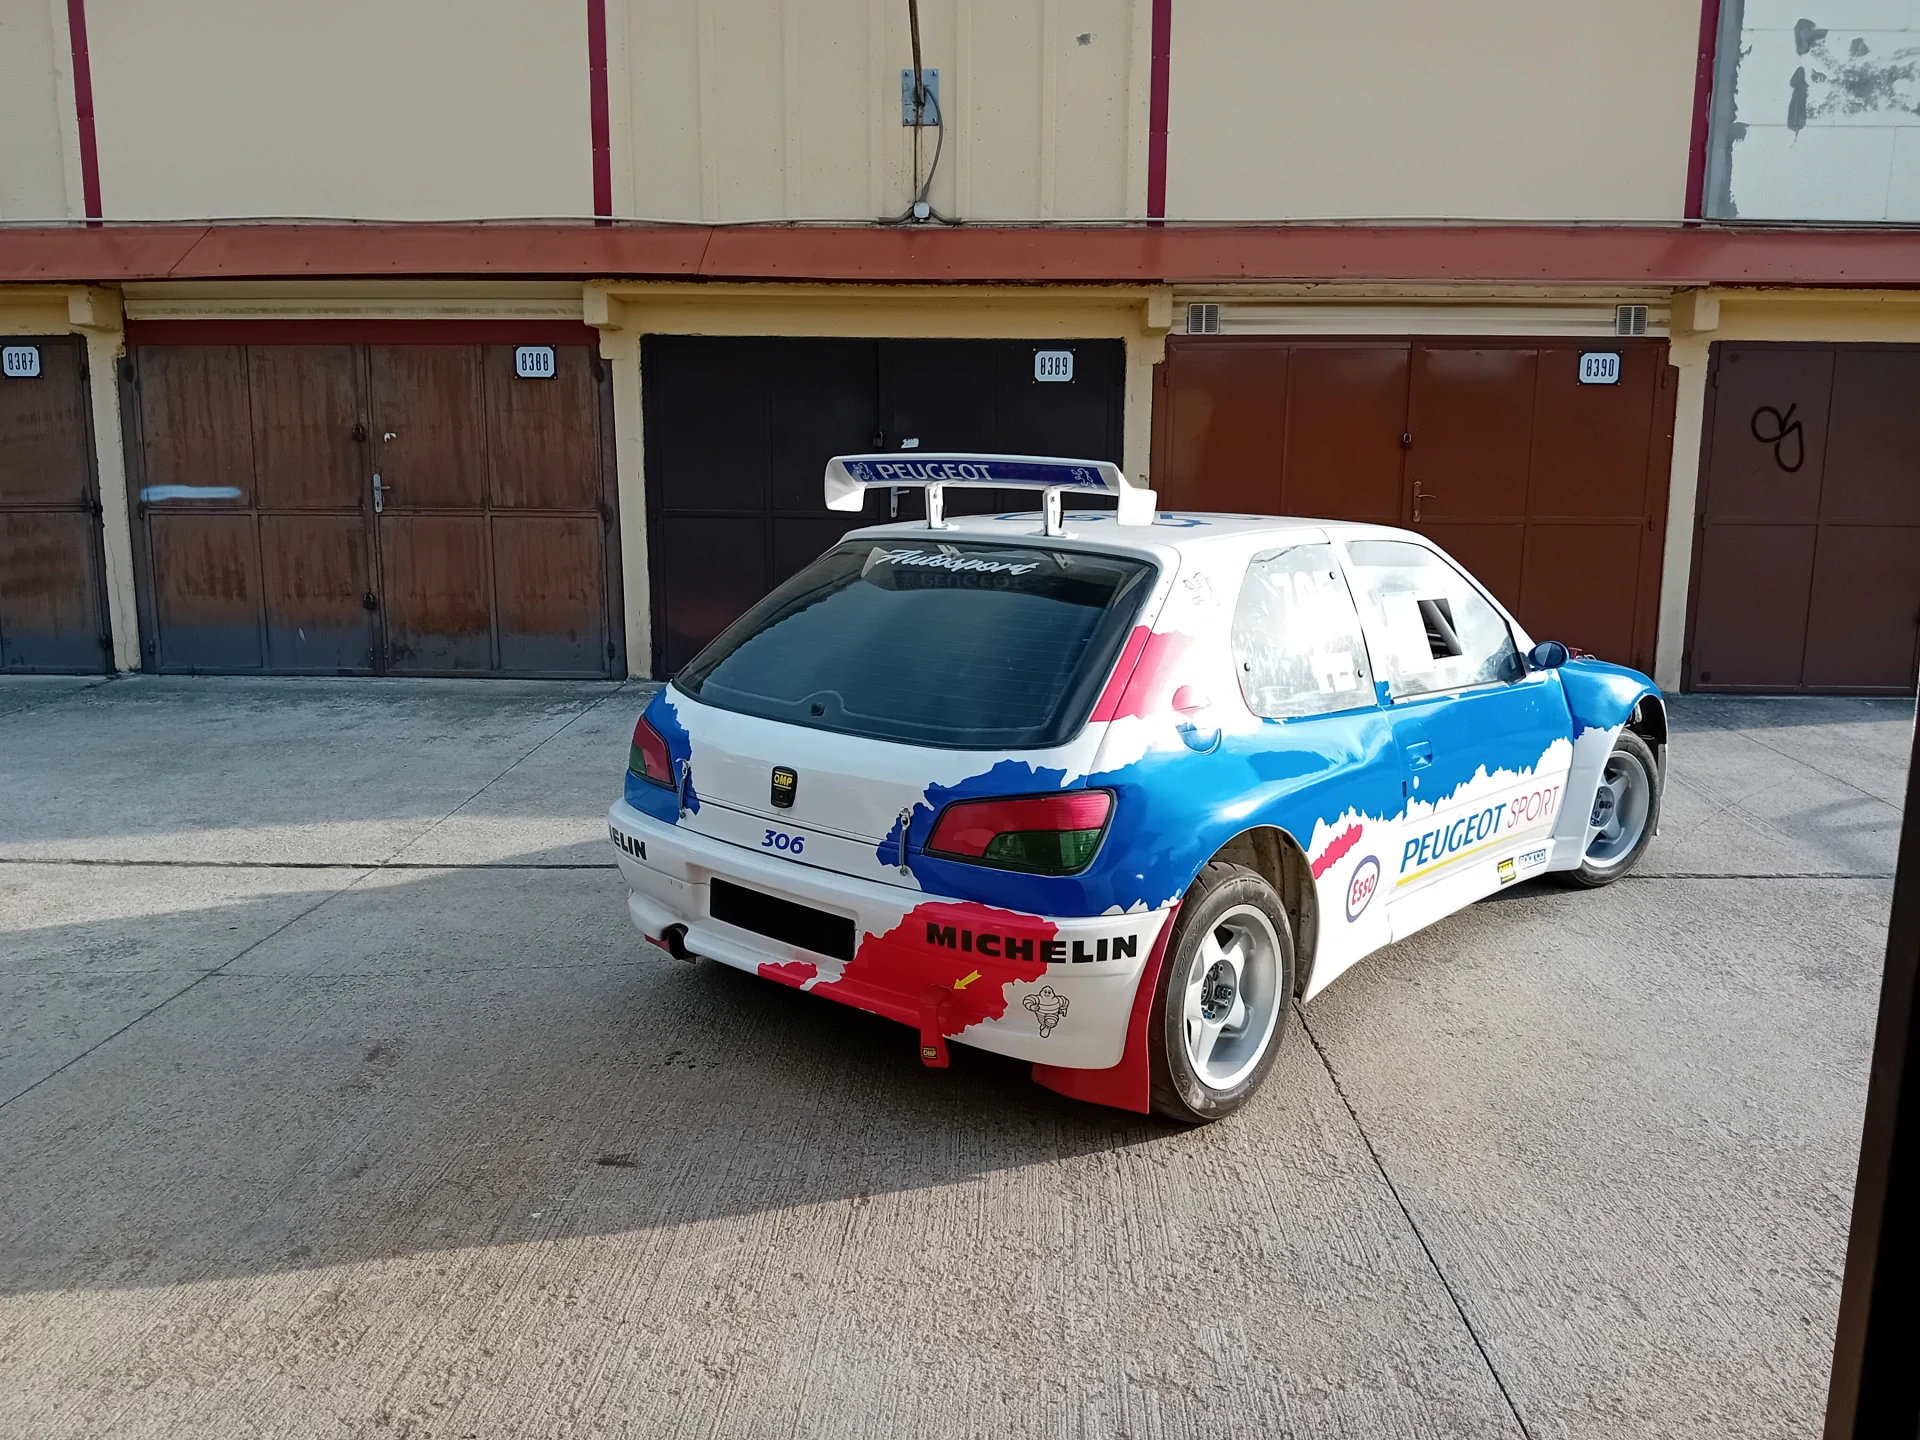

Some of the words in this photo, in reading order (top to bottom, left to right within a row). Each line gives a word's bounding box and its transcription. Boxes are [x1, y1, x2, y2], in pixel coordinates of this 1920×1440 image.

[7, 352, 34, 371] 8387
[521, 352, 549, 371] 8388
[1040, 356, 1068, 376] 8389
[1585, 358, 1615, 377] 8390
[875, 463, 993, 481] PEUGEOT
[875, 549, 1040, 576] Autosport
[774, 774, 793, 786] OMP
[1400, 803, 1507, 874] PEUGEOT
[1507, 786, 1560, 829] SPORT
[609, 823, 648, 861] ELIN
[761, 829, 805, 854] 306
[1351, 873, 1375, 906] Esso
[926, 922, 1138, 964] MICHELIN
